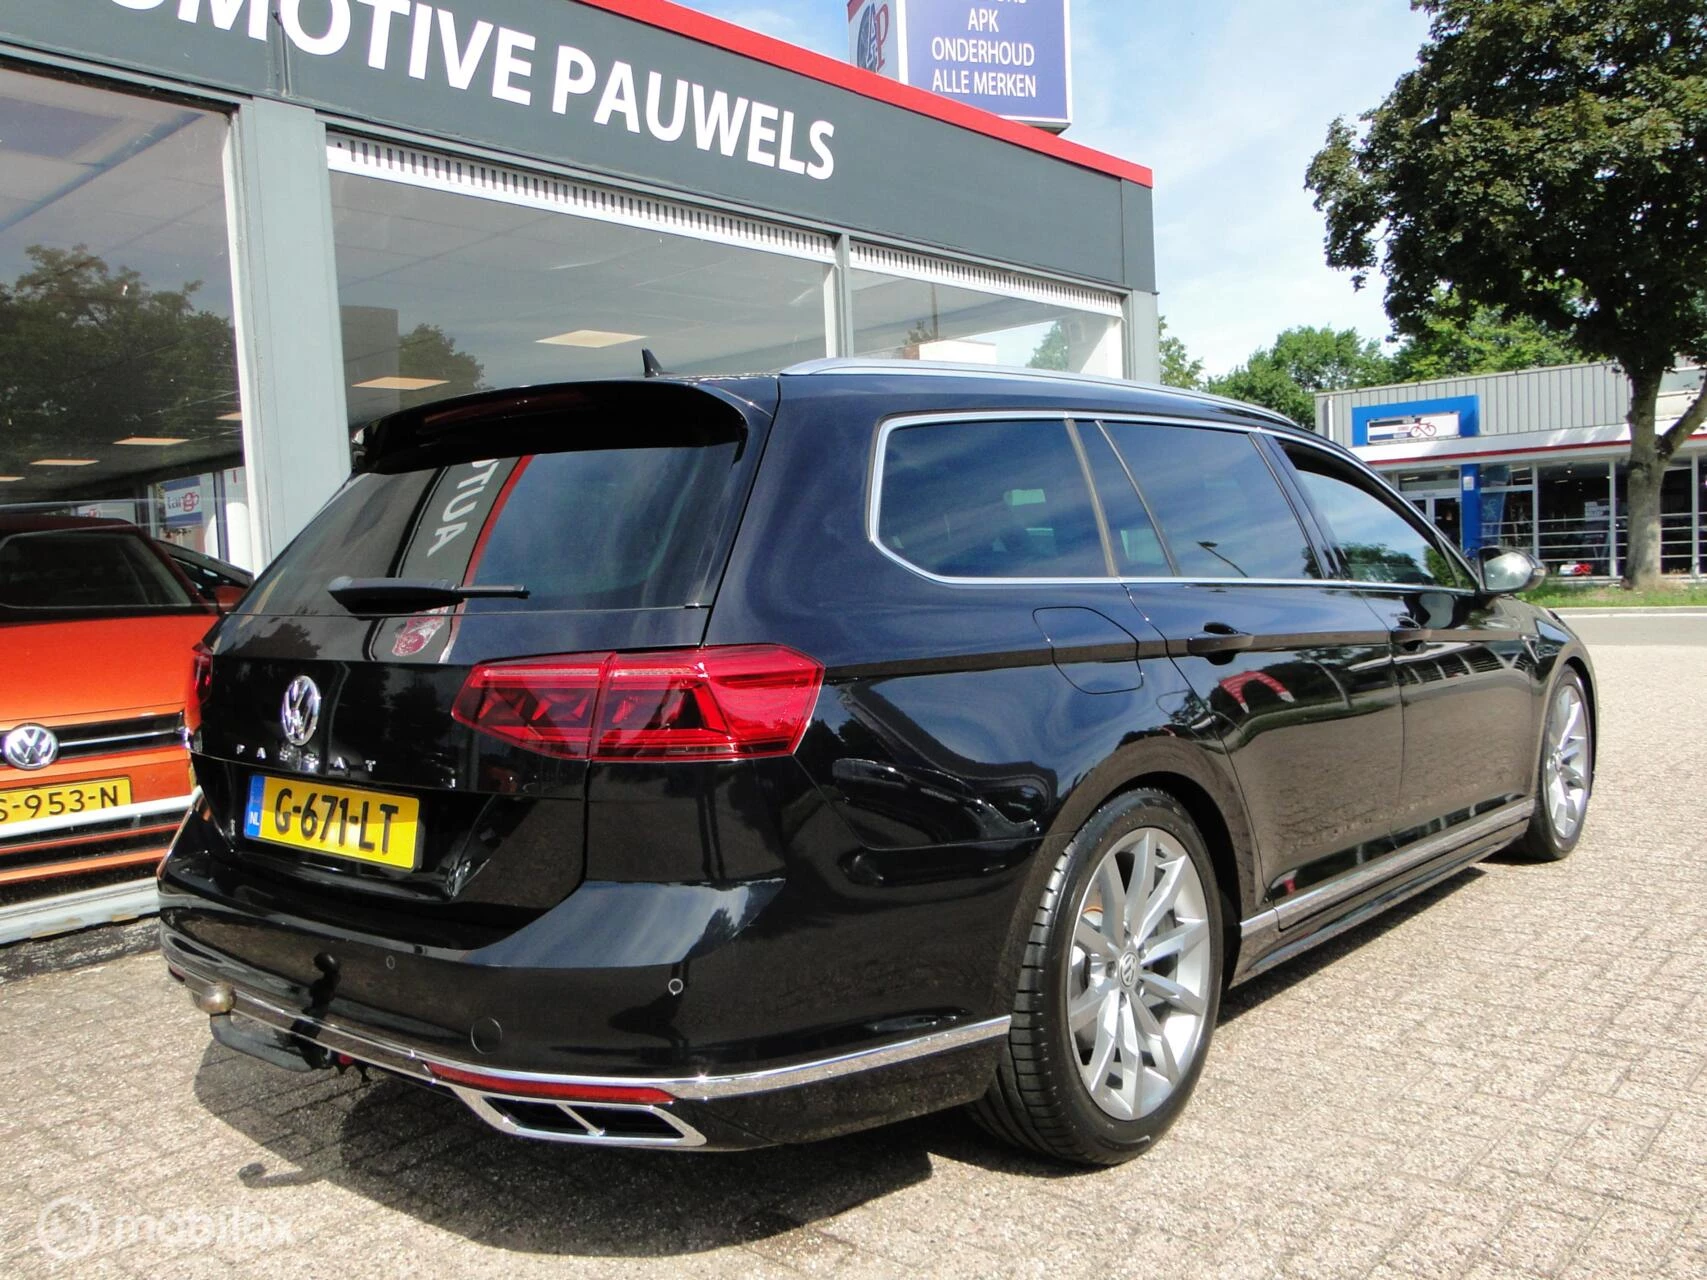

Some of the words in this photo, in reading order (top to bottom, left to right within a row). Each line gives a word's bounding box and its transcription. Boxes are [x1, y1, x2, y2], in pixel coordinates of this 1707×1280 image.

[967, 8, 1000, 33] APK
[931, 37, 1035, 66] ONDERHOUD
[111, 0, 536, 106] OTIVE
[552, 45, 835, 180] PAUWELS
[932, 69, 969, 94] ALLE
[973, 72, 1037, 98] MERKEN
[236, 744, 376, 772] PASSAT
[249, 811, 260, 826] NL
[274, 787, 399, 855] G-671-LT
